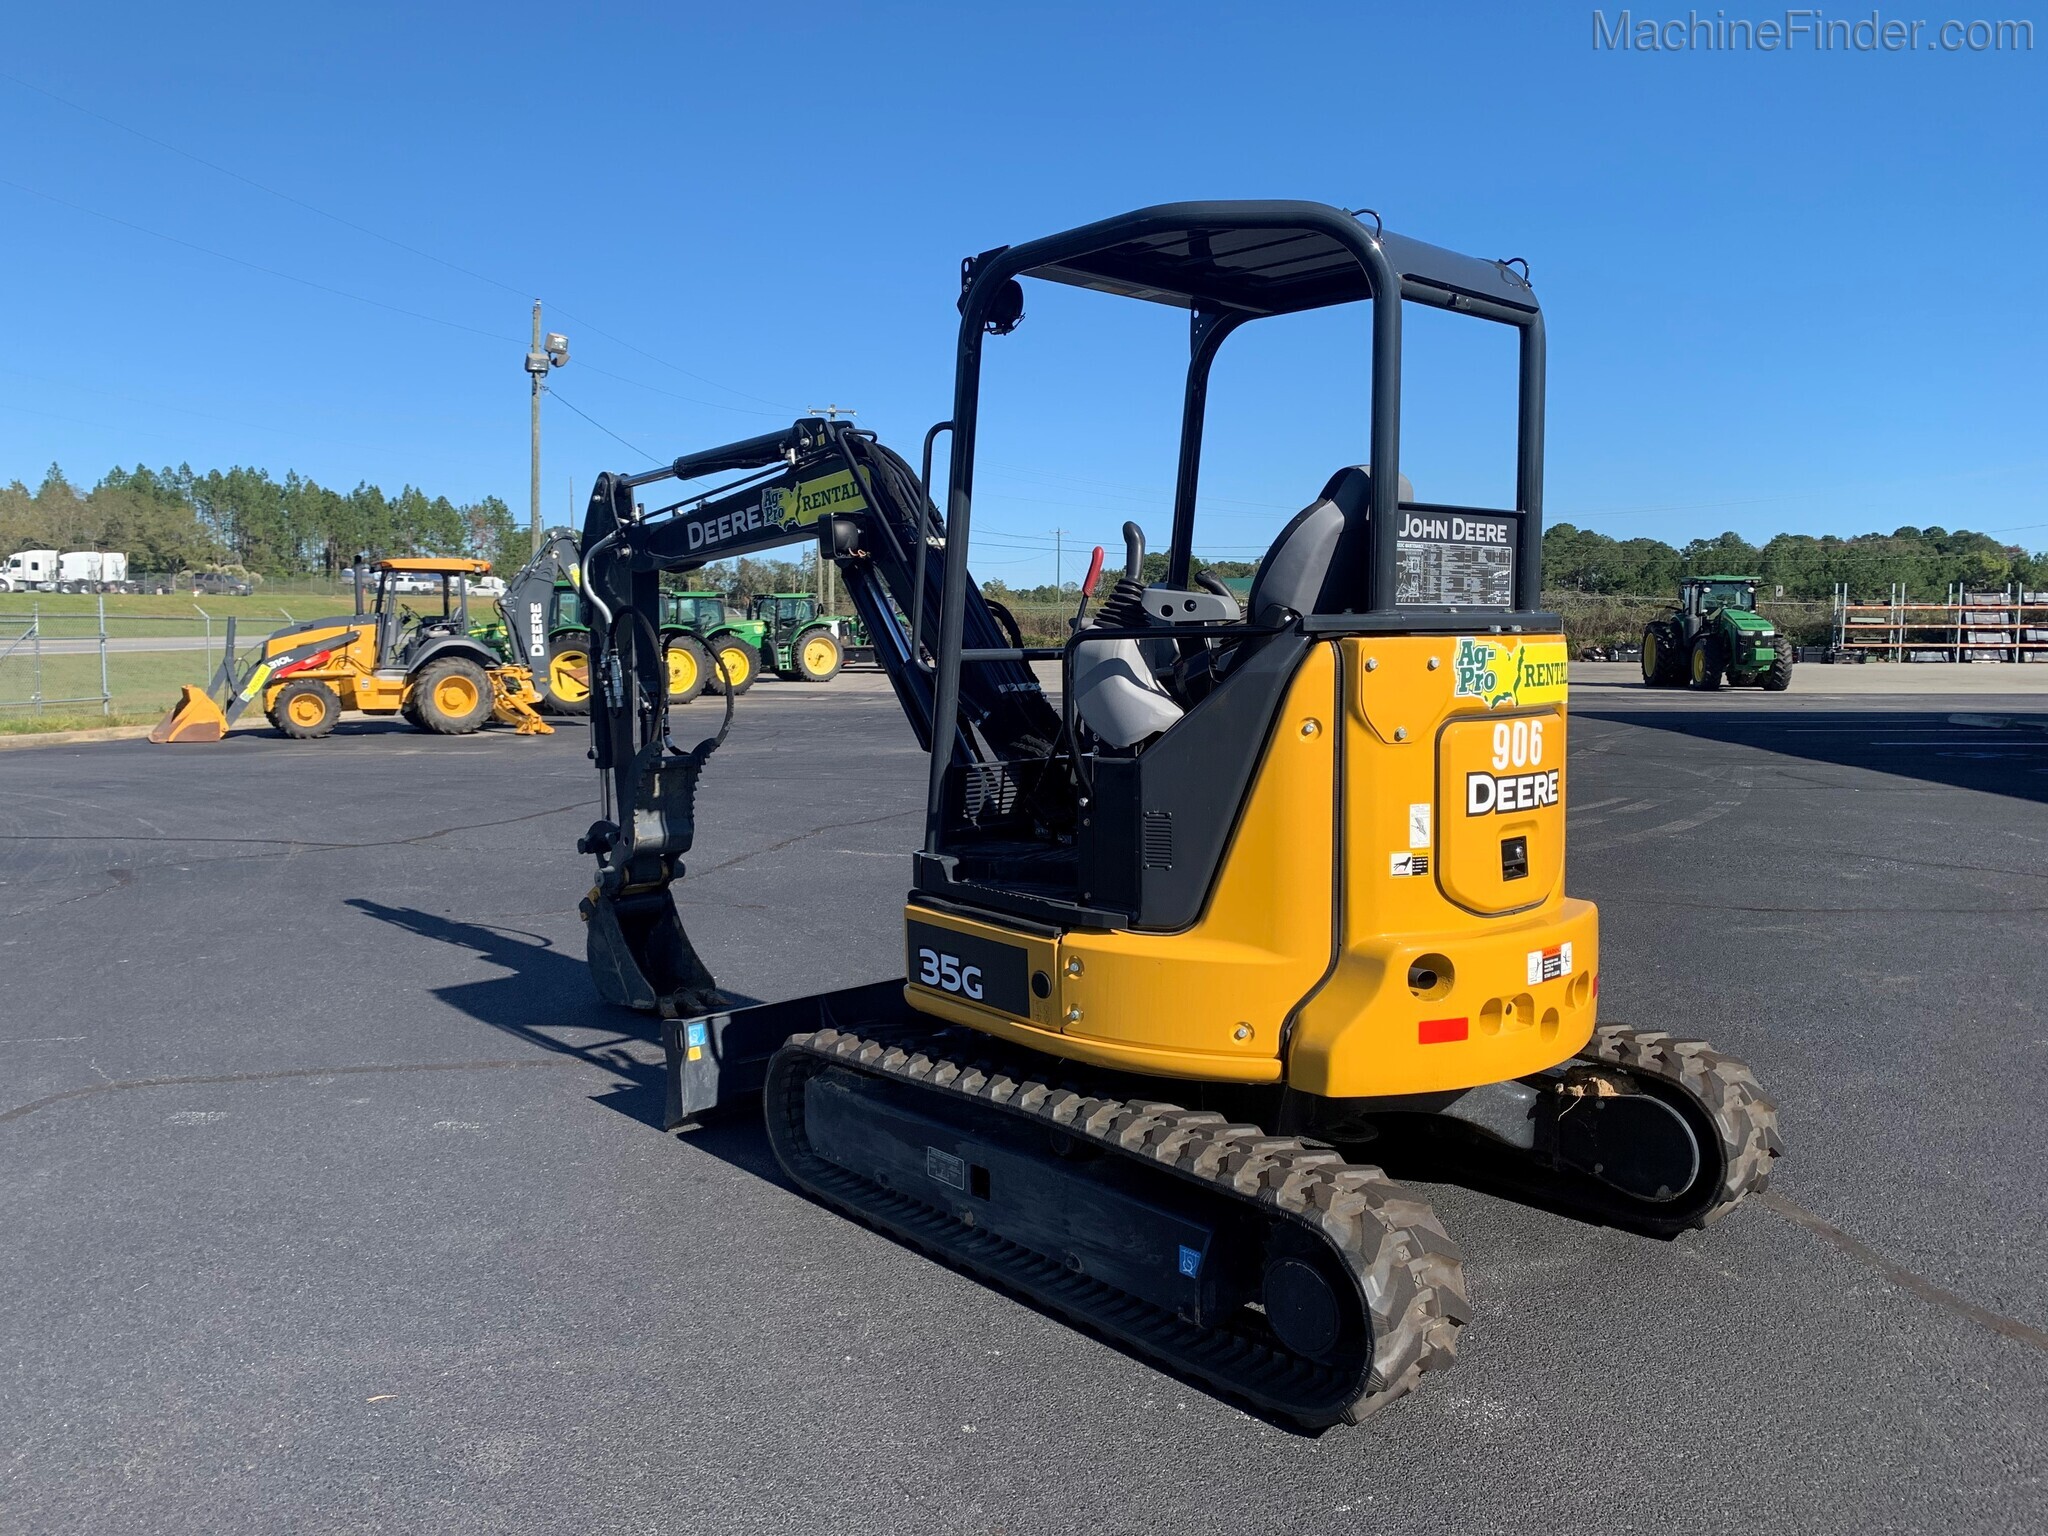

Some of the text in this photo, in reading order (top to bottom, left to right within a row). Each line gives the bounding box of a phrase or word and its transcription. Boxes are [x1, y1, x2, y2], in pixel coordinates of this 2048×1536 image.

[801, 478, 866, 511] RENTAL
[687, 505, 767, 550] DEERE
[765, 506, 785, 523] Pro
[1399, 513, 1507, 543] JOHN DEERE
[530, 603, 544, 656] DEERE
[267, 655, 294, 669] 310L
[1458, 639, 1496, 670] Ag-
[1457, 667, 1496, 694] Pro
[1492, 719, 1543, 771] 906
[1467, 769, 1559, 816] DEERE
[919, 948, 983, 1000] 35G
